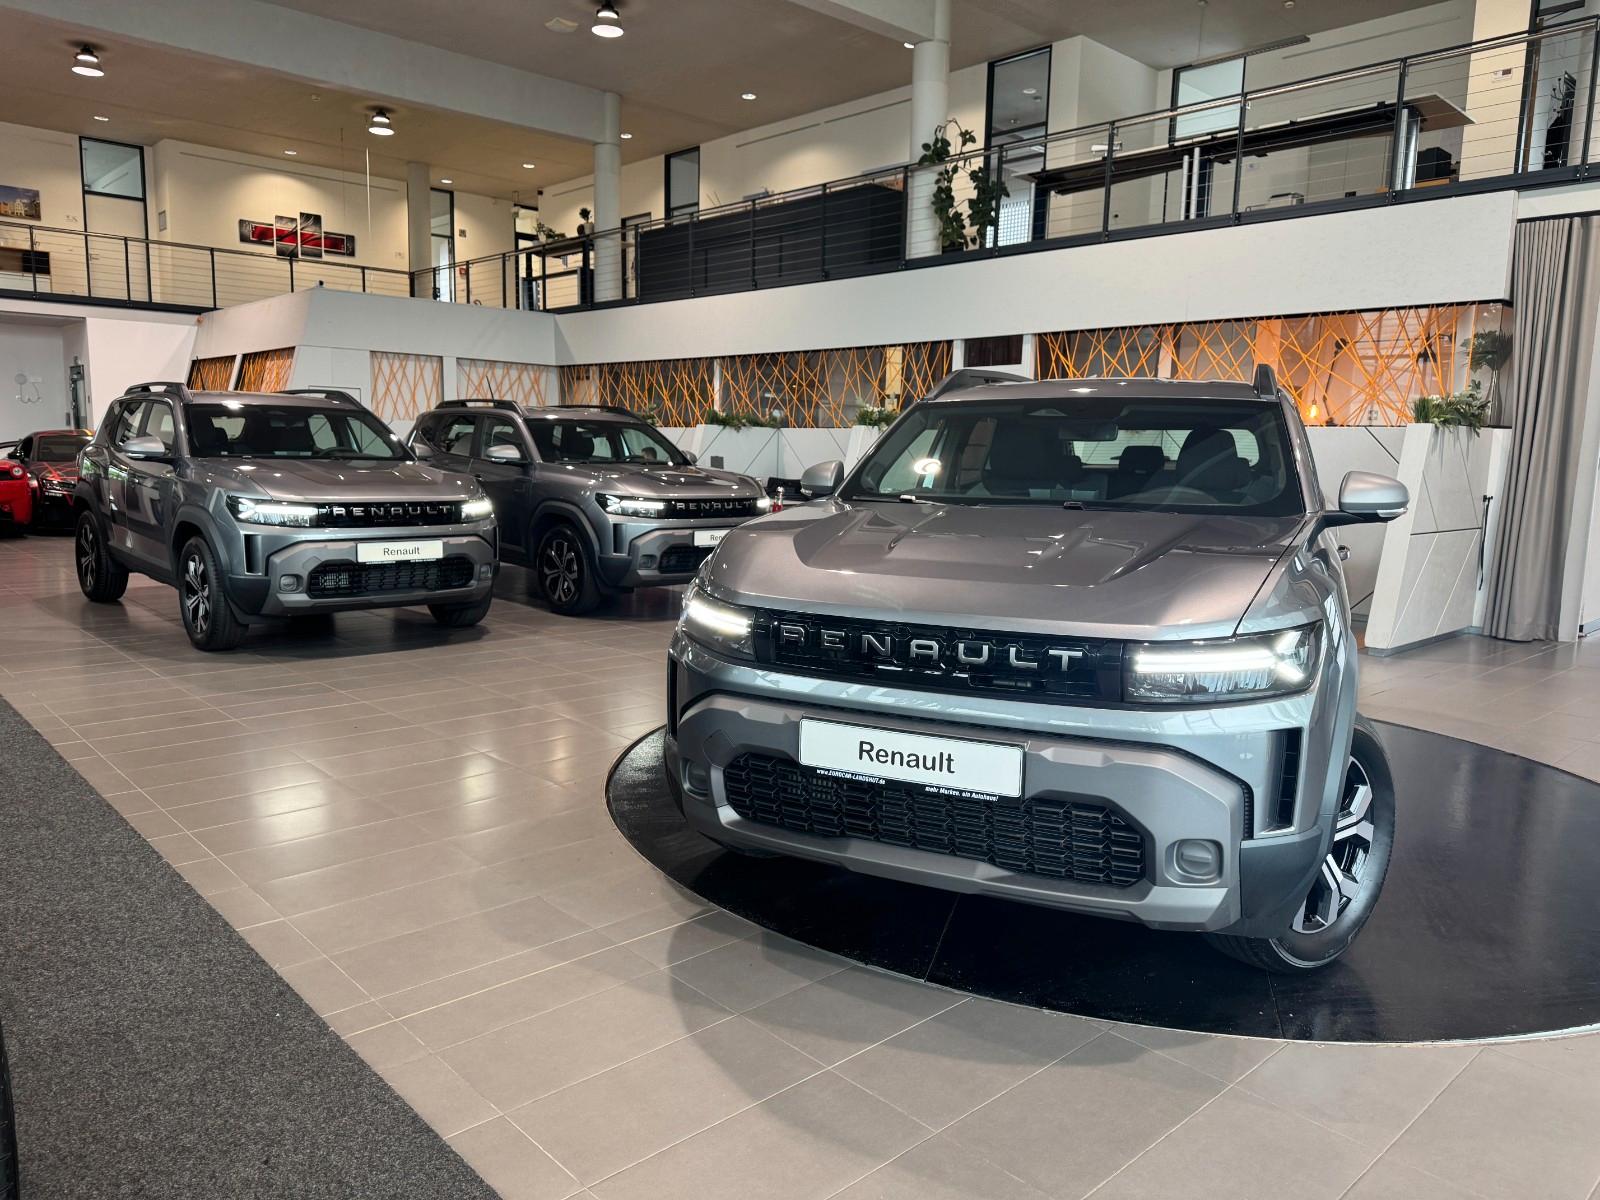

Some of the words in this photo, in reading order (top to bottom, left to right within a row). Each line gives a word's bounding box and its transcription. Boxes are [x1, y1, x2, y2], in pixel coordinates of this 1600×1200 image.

[332, 505, 450, 516] RENAULT
[676, 501, 751, 510] RENAULT
[383, 546, 420, 556] Renault
[780, 624, 1083, 672] RENAULT
[858, 740, 956, 775] Renault
